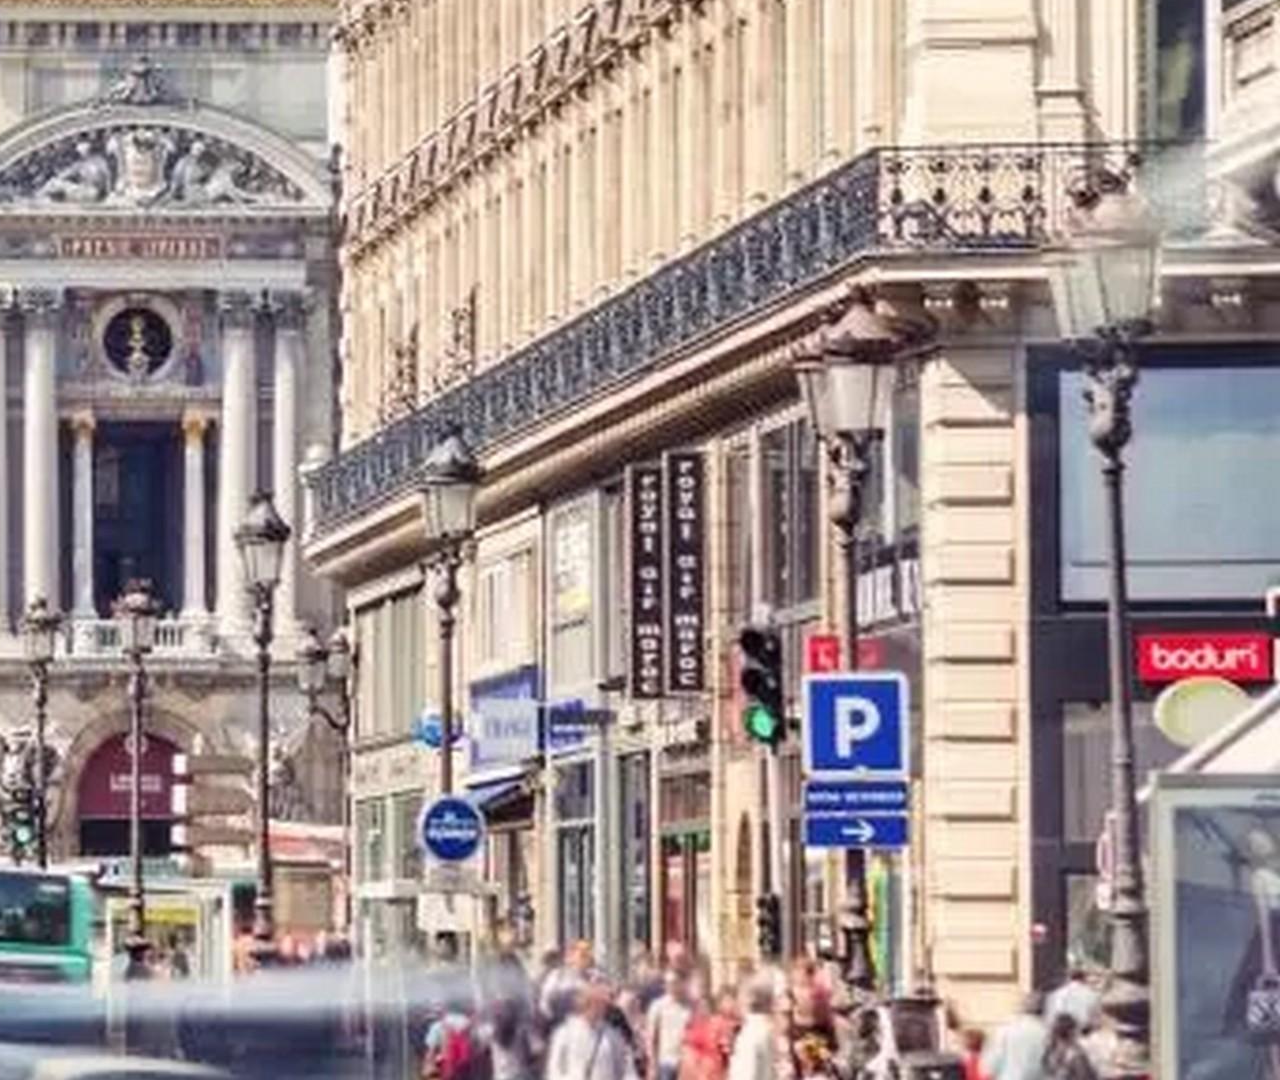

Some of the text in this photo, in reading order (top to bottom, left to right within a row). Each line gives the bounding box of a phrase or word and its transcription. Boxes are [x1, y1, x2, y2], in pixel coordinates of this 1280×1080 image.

[637, 475, 660, 694] royal air maroc
[674, 461, 698, 685] royal air maroc
[835, 696, 881, 758] P
